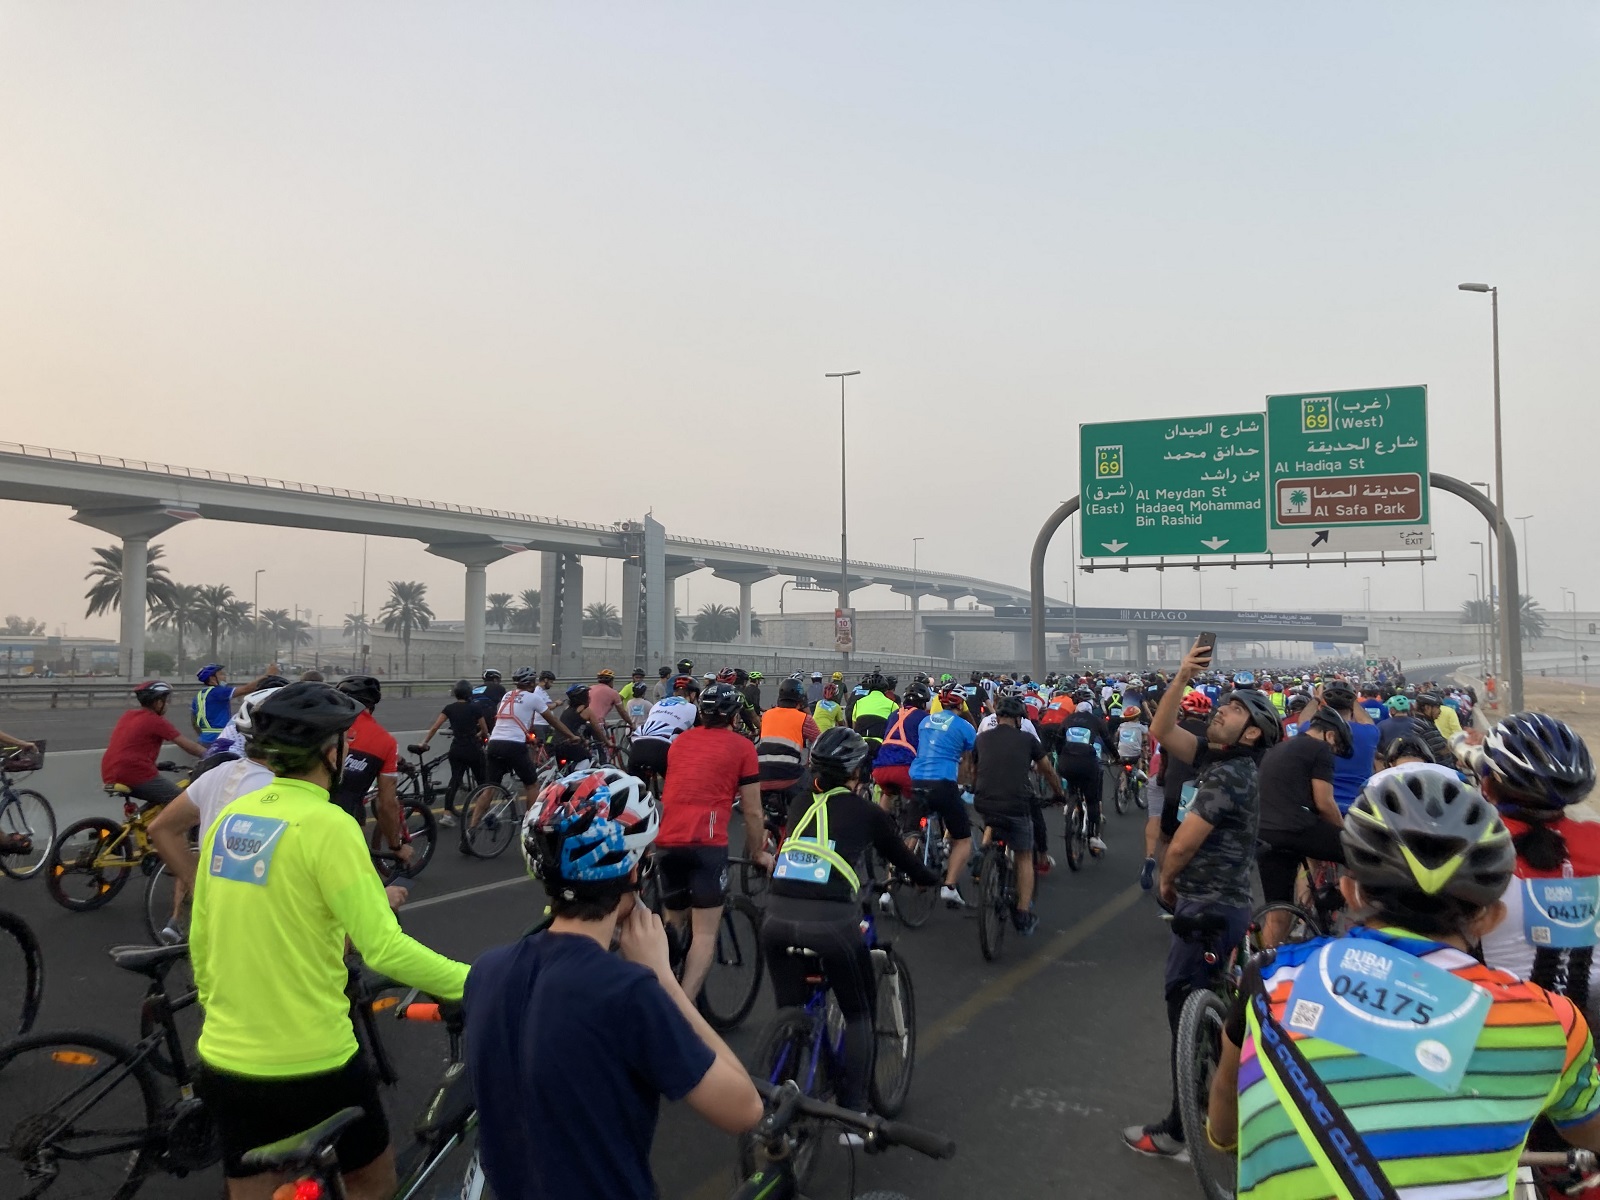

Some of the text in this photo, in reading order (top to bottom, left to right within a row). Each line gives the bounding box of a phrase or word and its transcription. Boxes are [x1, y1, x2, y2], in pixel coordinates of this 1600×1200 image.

[1307, 405, 1314, 413] D
[1306, 414, 1328, 428] 69
[1335, 415, 1384, 431] (West)
[1165, 420, 1260, 440] شارع الميدان
[1307, 435, 1419, 455] شارع الحديقة
[1163, 450, 1207, 461] محمد
[1100, 461, 1119, 474] 69
[1275, 457, 1365, 473] Al Hadiqa St
[1200, 467, 1260, 483] بن راشد
[1136, 486, 1227, 502] Al Meydan St
[1313, 484, 1416, 499] حديقة الصفا
[1086, 503, 1125, 516] (East)
[1136, 499, 1261, 515] Hadaeq Mohammad
[1314, 502, 1406, 517] Al Safa Park
[1136, 514, 1203, 527] Bin Rashid
[1133, 611, 1187, 620] ALPAGO
[226, 836, 262, 854] 08590
[1344, 947, 1393, 972] DUBAI
[1332, 974, 1434, 1025] 04175
